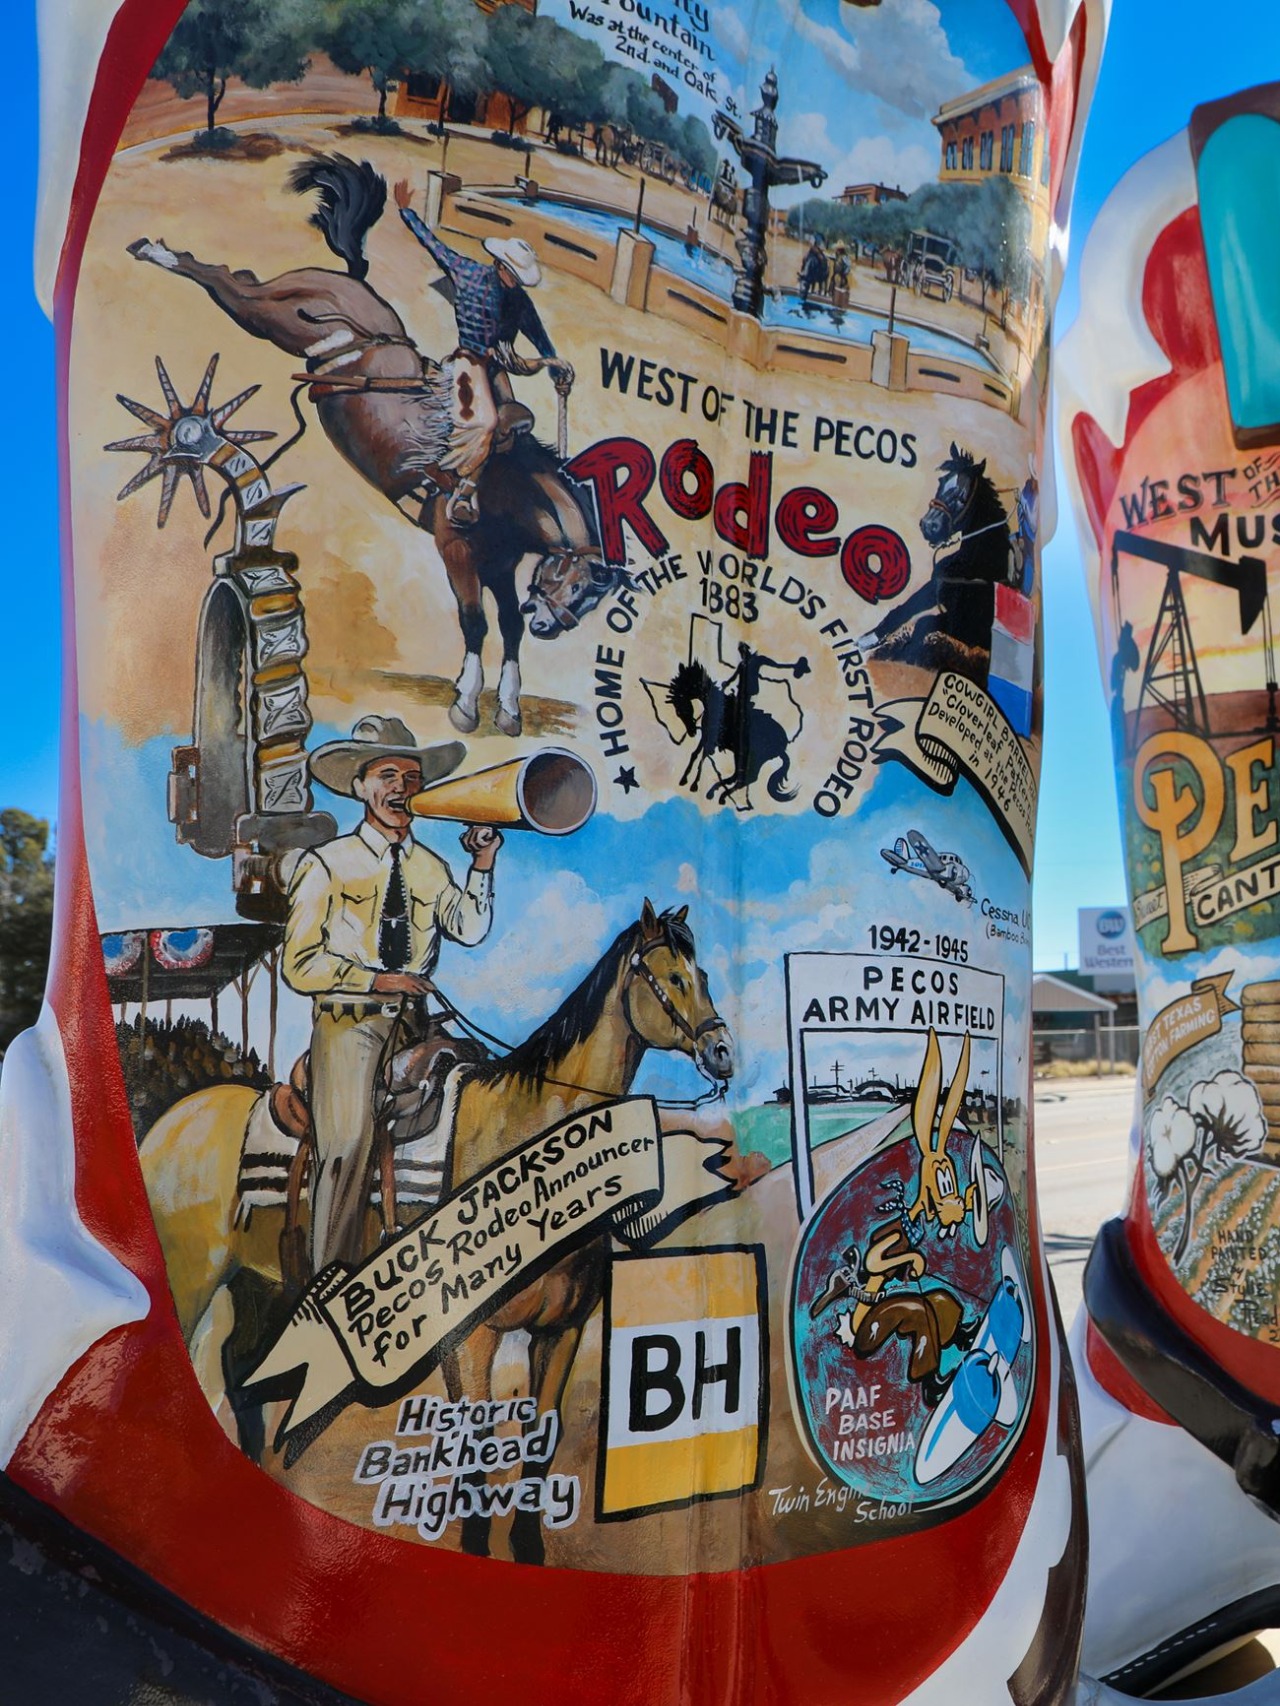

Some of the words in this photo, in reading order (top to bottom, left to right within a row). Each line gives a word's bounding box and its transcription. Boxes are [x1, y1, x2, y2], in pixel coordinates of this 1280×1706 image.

[569, 0, 604, 26] Was
[607, 20, 625, 34] at
[627, 26, 650, 44] the
[652, 40, 699, 70] center
[703, 71, 716, 84] of
[600, 0, 716, 61] ountain
[653, 59, 680, 79] and
[684, 71, 718, 104] Oak
[725, 96, 742, 119] St.
[600, 347, 698, 414] WEST
[701, 385, 735, 426] OF
[744, 399, 799, 448] THE
[813, 416, 918, 468] PECOS
[558, 436, 911, 604] Rodeo
[1118, 468, 1237, 530] WEST
[1242, 457, 1264, 481] OF
[635, 554, 688, 596] THE
[698, 577, 759, 623] 1883
[606, 588, 640, 634] OF
[819, 618, 875, 709] FIRST
[594, 645, 630, 757] HOME
[928, 702, 983, 751] Developed
[983, 748, 994, 764] at
[995, 760, 1008, 785] the
[944, 674, 998, 730] COWGIRL
[1001, 726, 1029, 786] BARREL
[813, 716, 875, 818] RODEO
[969, 751, 979, 768] in
[985, 768, 1011, 812] 1946
[981, 898, 1019, 927] Cessna
[1085, 957, 1134, 969] Western
[1097, 944, 1126, 956] Best
[863, 966, 959, 995] PECOS
[802, 996, 900, 1023] ARMY
[911, 999, 995, 1030] AIRFIELD
[1162, 996, 1203, 1030] TEXAS
[1169, 1008, 1216, 1046] FARMING
[339, 1219, 446, 1320] BUCK
[458, 1109, 614, 1225] JACKSON
[348, 1259, 445, 1348] Pecos
[447, 1199, 529, 1264] Rodeo
[533, 1136, 655, 1210] Announcer
[1218, 1230, 1254, 1243] HAND
[372, 1314, 429, 1367] for
[441, 1243, 522, 1314] Many
[527, 1174, 622, 1241] Years
[628, 1326, 742, 1433] BH
[825, 1384, 882, 1415] PAAF
[398, 1396, 537, 1436] Historic
[838, 1409, 896, 1436] BASE
[358, 1414, 552, 1481] Bankhead
[832, 1431, 915, 1461] INSIGNIA
[379, 1477, 575, 1534] Highway
[768, 1485, 811, 1516] Twin
[814, 1477, 870, 1513] Engin
[854, 1495, 913, 1523] School
